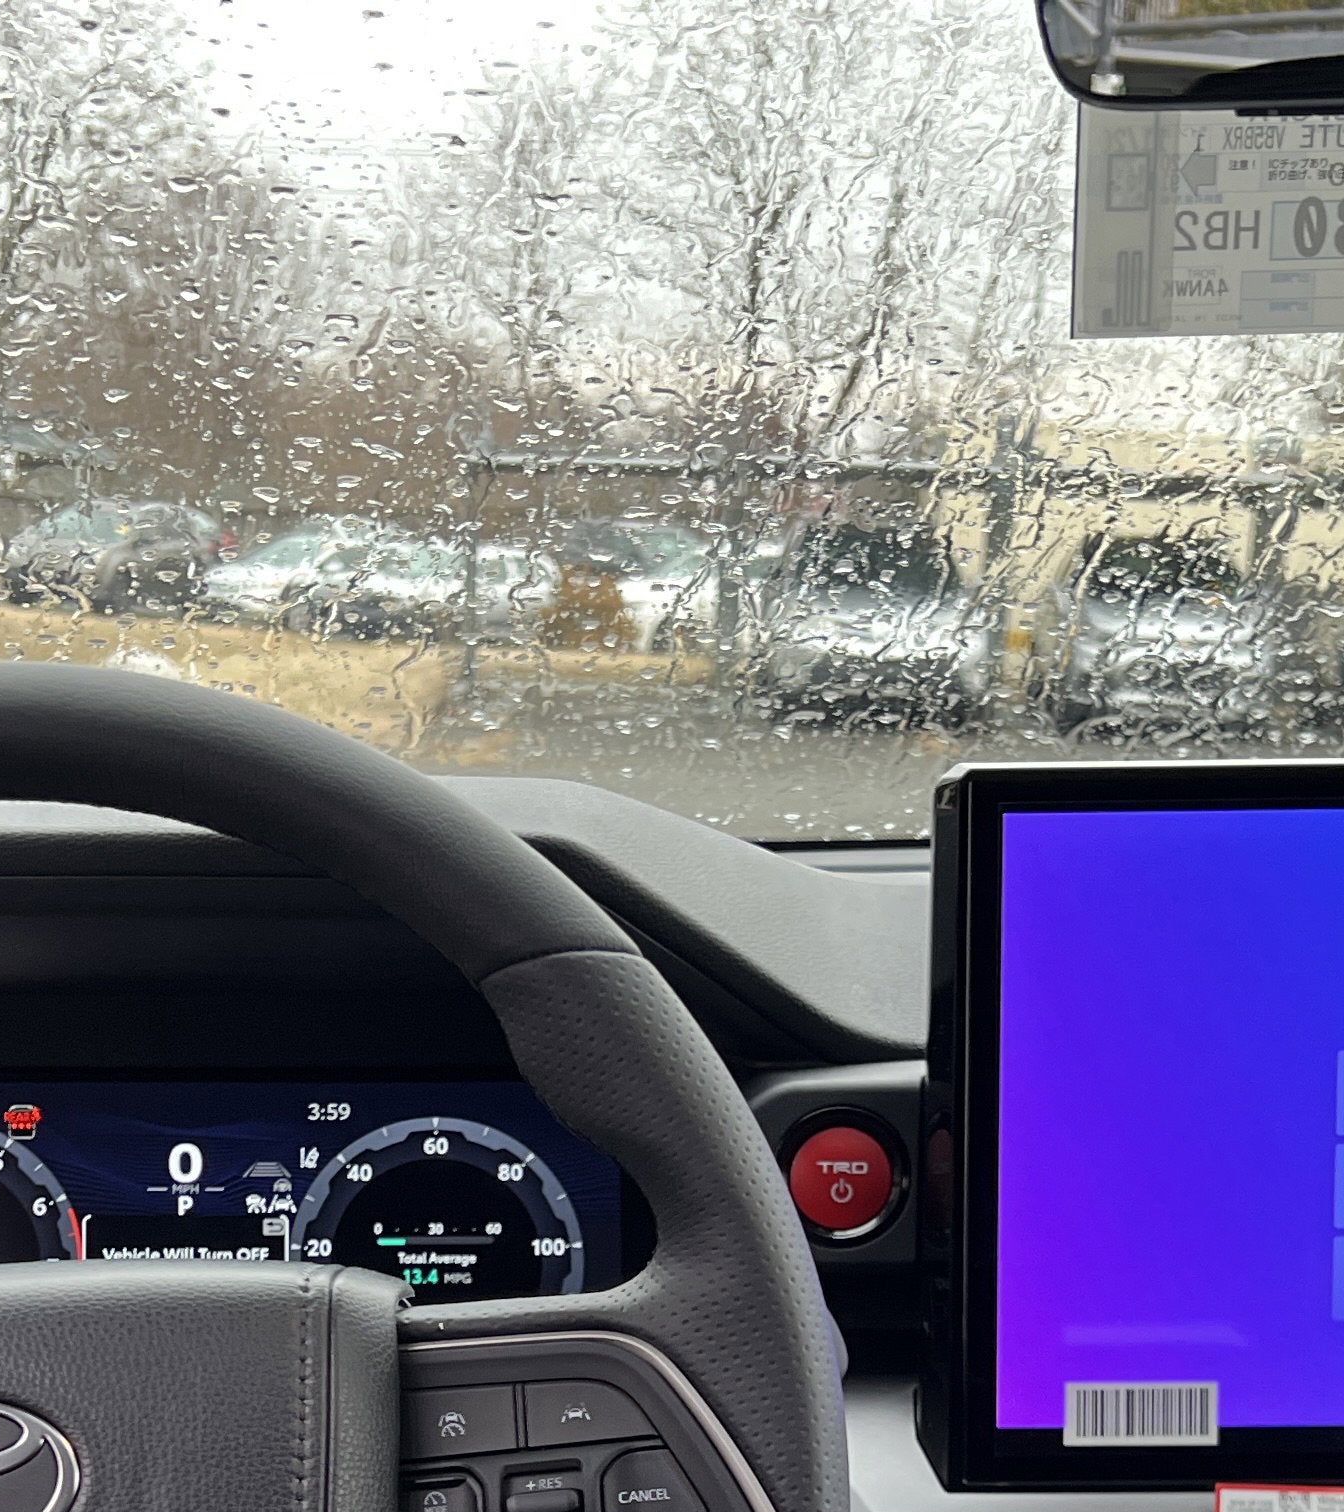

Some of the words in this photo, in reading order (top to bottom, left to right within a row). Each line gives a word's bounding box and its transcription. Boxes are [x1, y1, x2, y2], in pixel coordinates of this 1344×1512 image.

[307, 1102, 351, 1121] 3:59
[423, 1137, 449, 1155] 60
[168, 1142, 203, 1183] 0
[816, 1161, 869, 1175] TRD
[347, 1164, 373, 1182] 40
[497, 1164, 524, 1182] 80
[172, 1184, 199, 1195] MPH
[32, 1197, 47, 1216] 6
[177, 1195, 194, 1216] P
[373, 1222, 383, 1235] 0
[427, 1222, 445, 1236] 30
[485, 1222, 503, 1236] 60
[102, 1247, 161, 1261] Vehicle
[163, 1247, 195, 1261] Will
[198, 1248, 233, 1261] Turn
[236, 1247, 270, 1261] OFF
[307, 1239, 333, 1257] 20
[531, 1238, 566, 1257] 100
[397, 1252, 427, 1266] Total
[427, 1252, 477, 1267] Average
[402, 1269, 439, 1286] 13.4
[443, 1273, 473, 1285] MPG
[538, 1476, 563, 1490] RES
[618, 1487, 671, 1505] CANCEL
